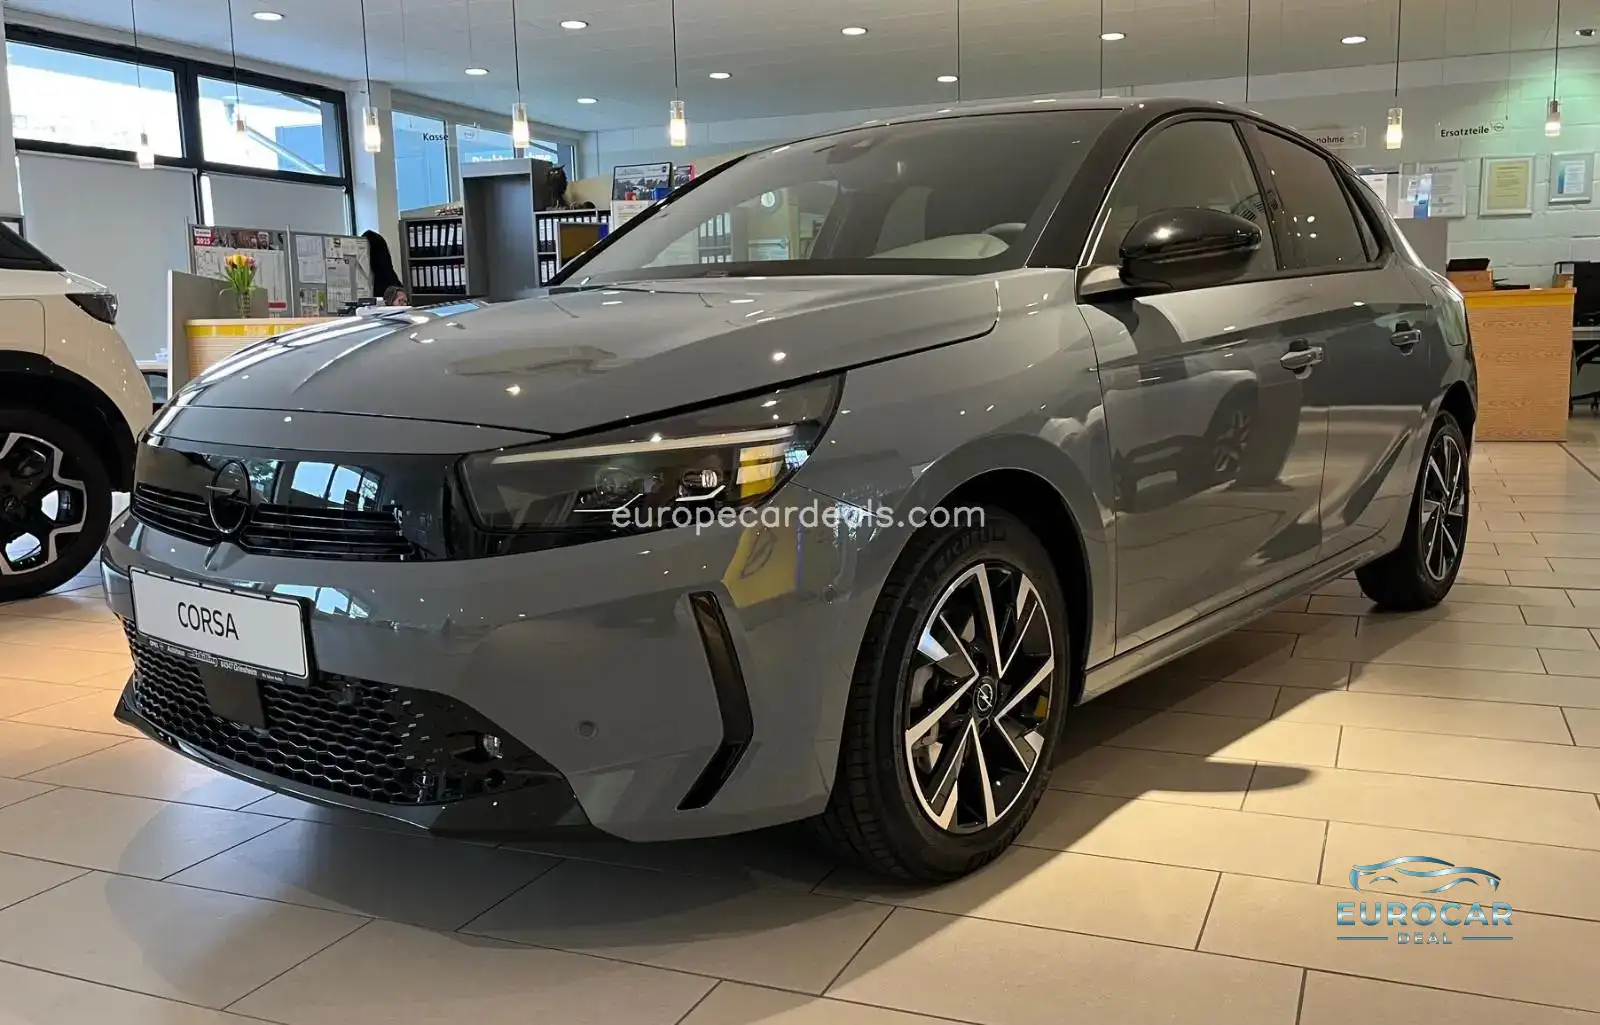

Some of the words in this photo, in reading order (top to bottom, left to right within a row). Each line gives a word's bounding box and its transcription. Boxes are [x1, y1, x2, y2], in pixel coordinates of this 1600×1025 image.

[423, 133, 449, 141] Kasse
[1441, 126, 1489, 138] Ersatzteile
[177, 601, 240, 641] CORSA
